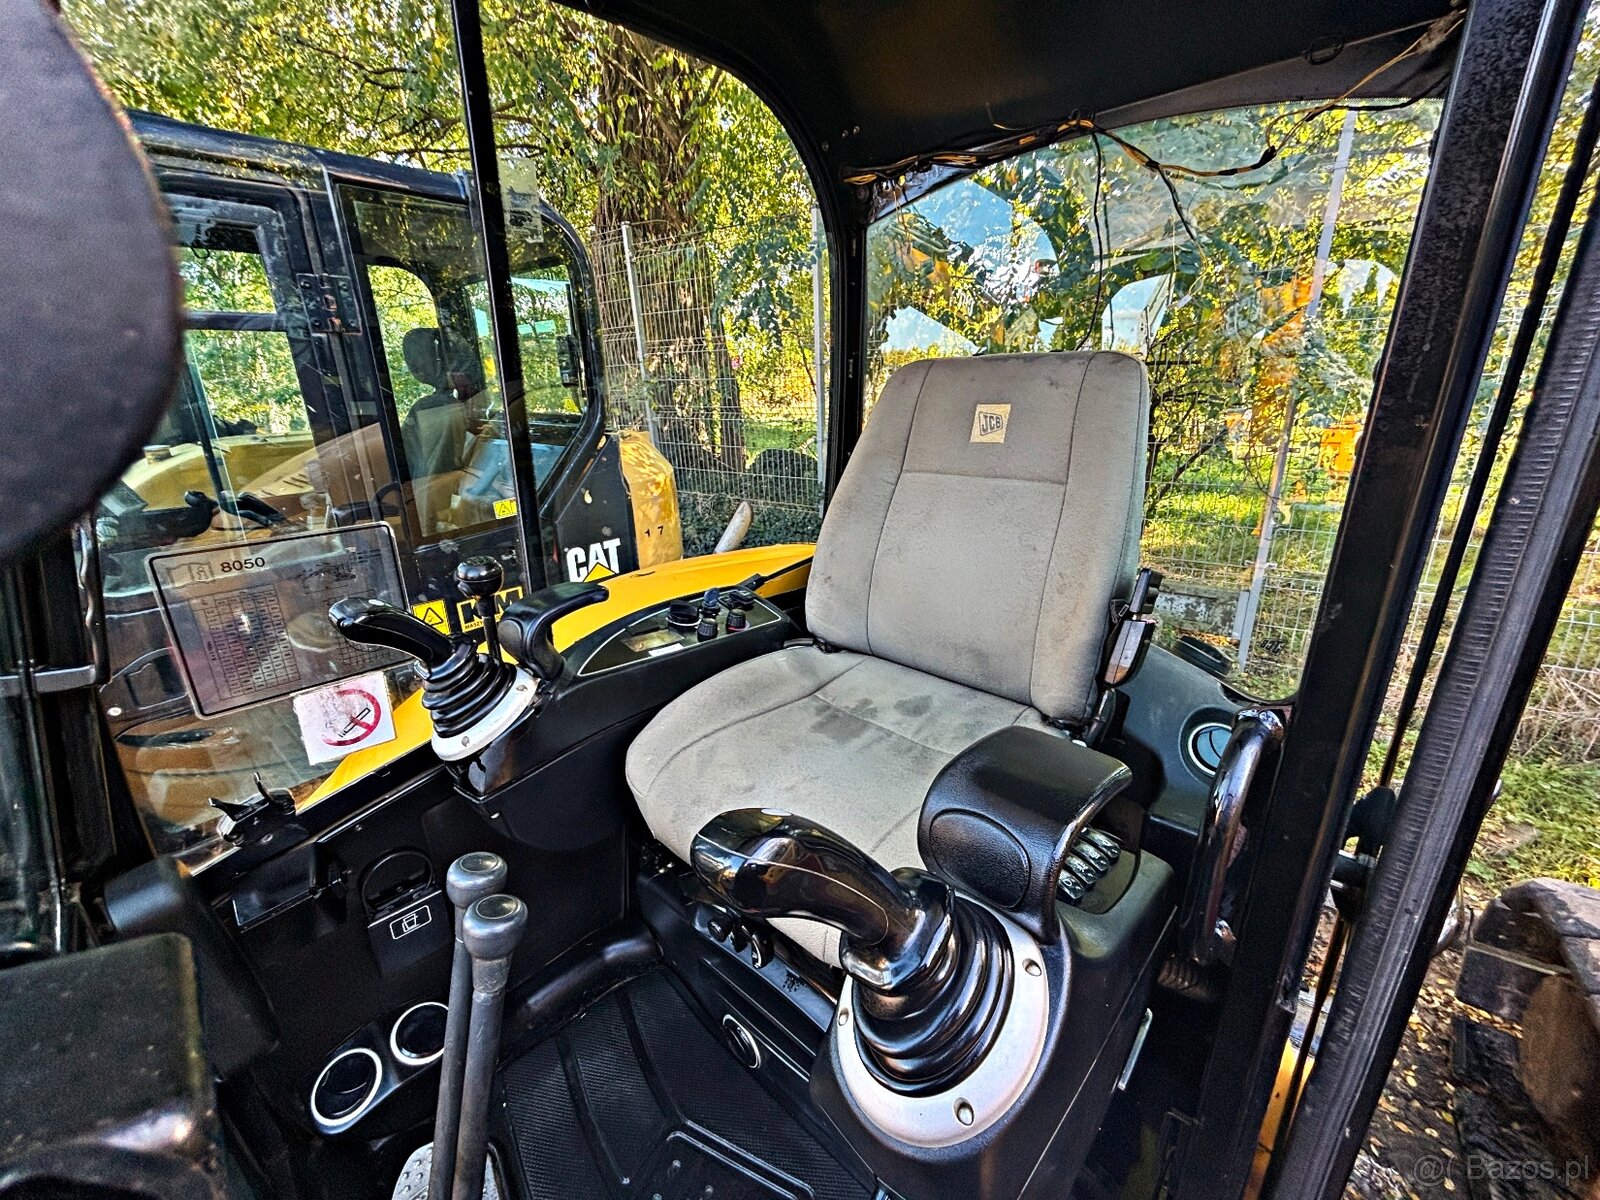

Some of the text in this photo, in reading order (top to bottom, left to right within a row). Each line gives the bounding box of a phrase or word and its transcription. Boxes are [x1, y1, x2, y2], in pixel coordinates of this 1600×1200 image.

[981, 413, 1001, 433] JCB
[221, 556, 266, 573] 8050
[566, 538, 621, 582] CAT
